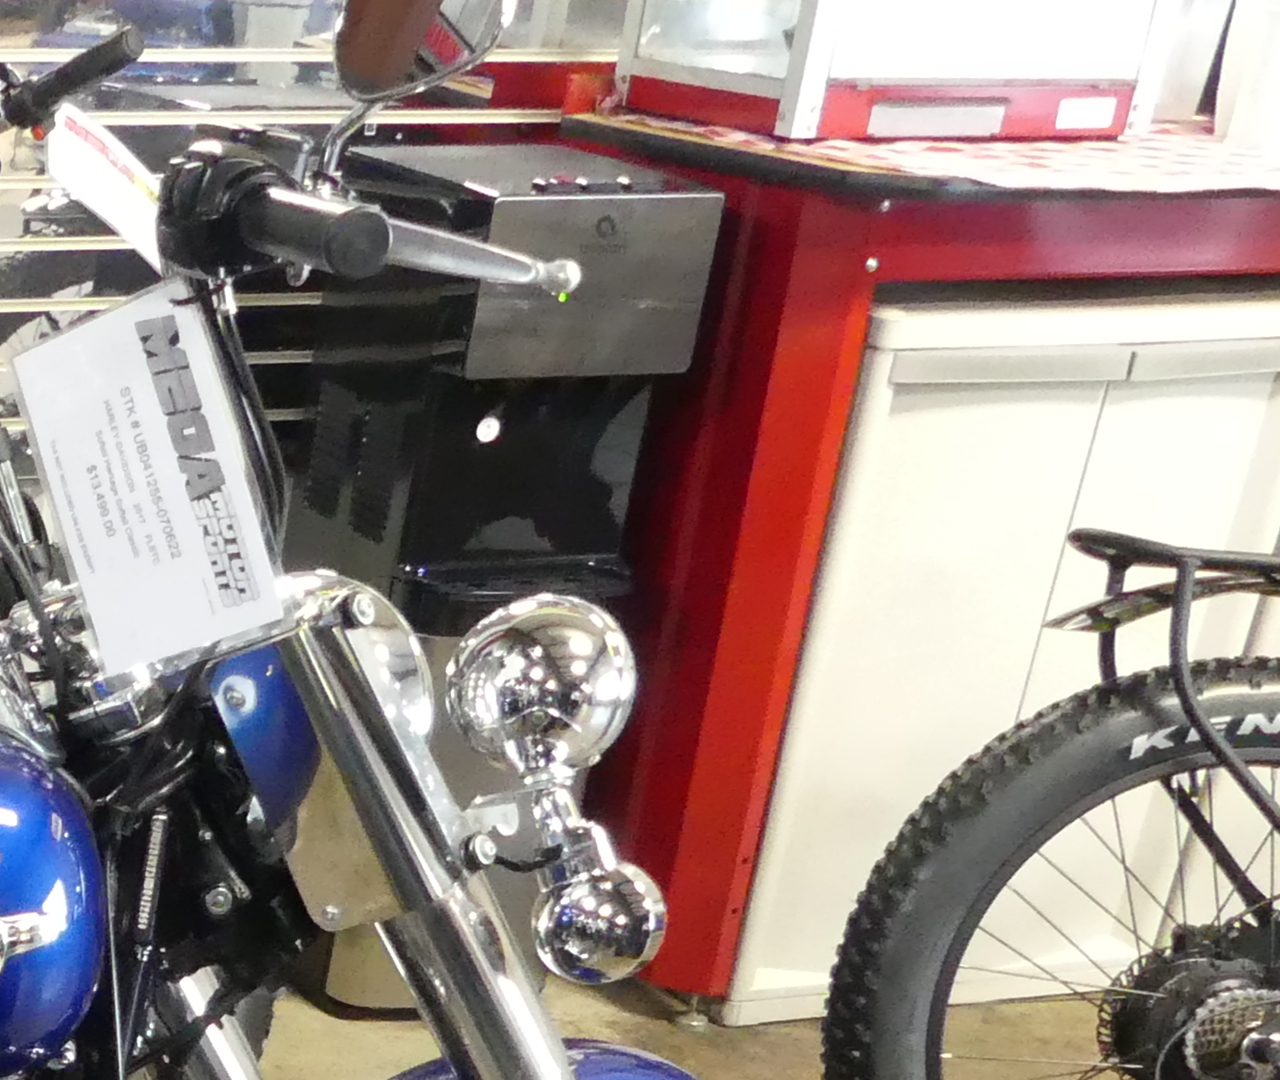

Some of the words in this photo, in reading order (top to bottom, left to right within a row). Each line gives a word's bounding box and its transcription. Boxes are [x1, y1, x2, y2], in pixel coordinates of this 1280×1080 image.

[120, 386, 138, 418] STK
[130, 419, 140, 429] #
[135, 315, 225, 501] MEGA
[190, 495, 241, 608] SPORTS
[209, 488, 260, 603] MOTOR
